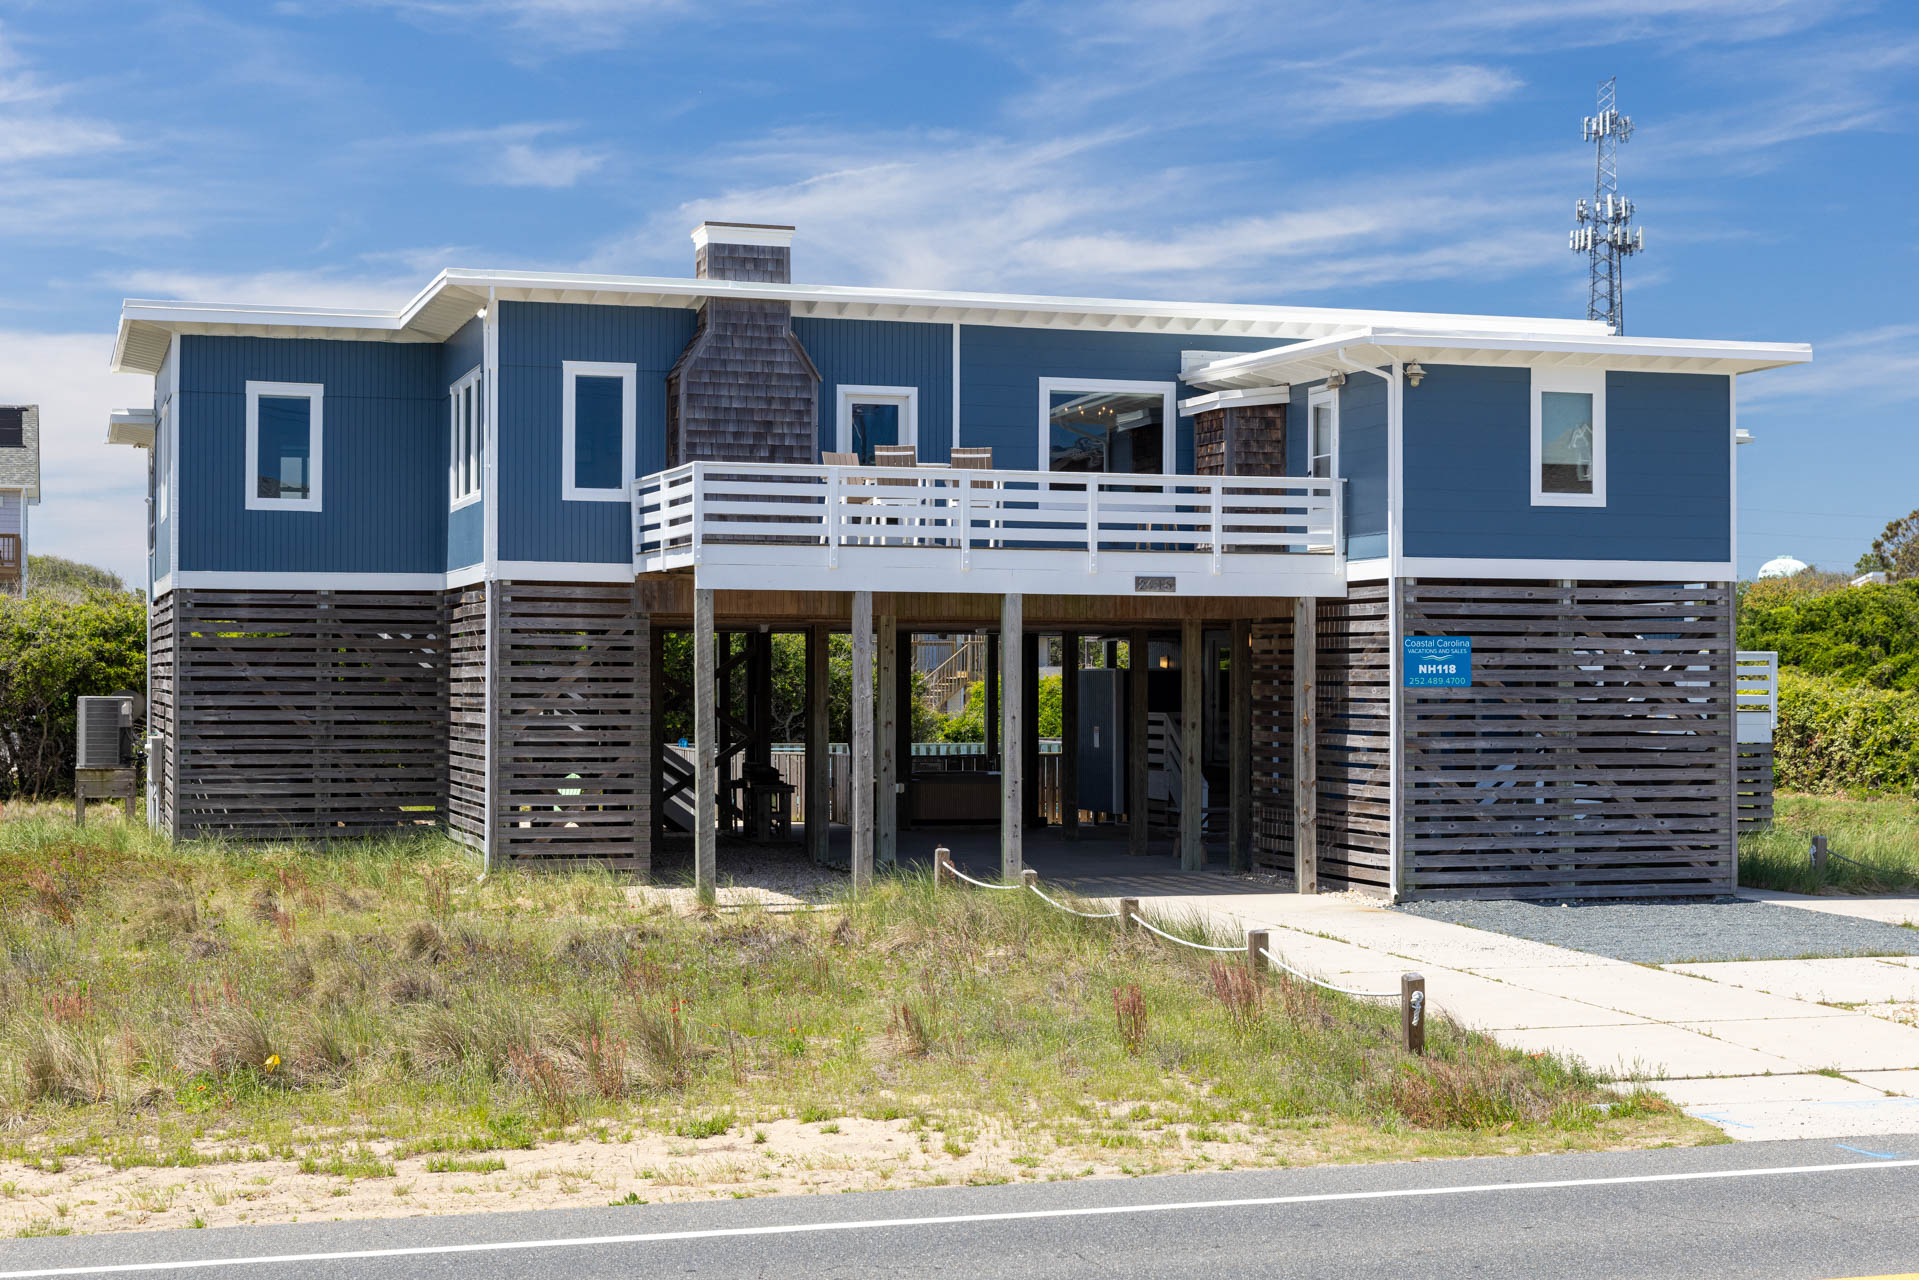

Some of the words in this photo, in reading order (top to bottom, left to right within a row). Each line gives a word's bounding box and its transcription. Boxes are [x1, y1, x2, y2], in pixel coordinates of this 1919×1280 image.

[1404, 638, 1435, 647] Coastal
[1436, 638, 1470, 647] Carolina
[1418, 664, 1456, 674] NH118
[1409, 677, 1466, 685] 252.489.4700
